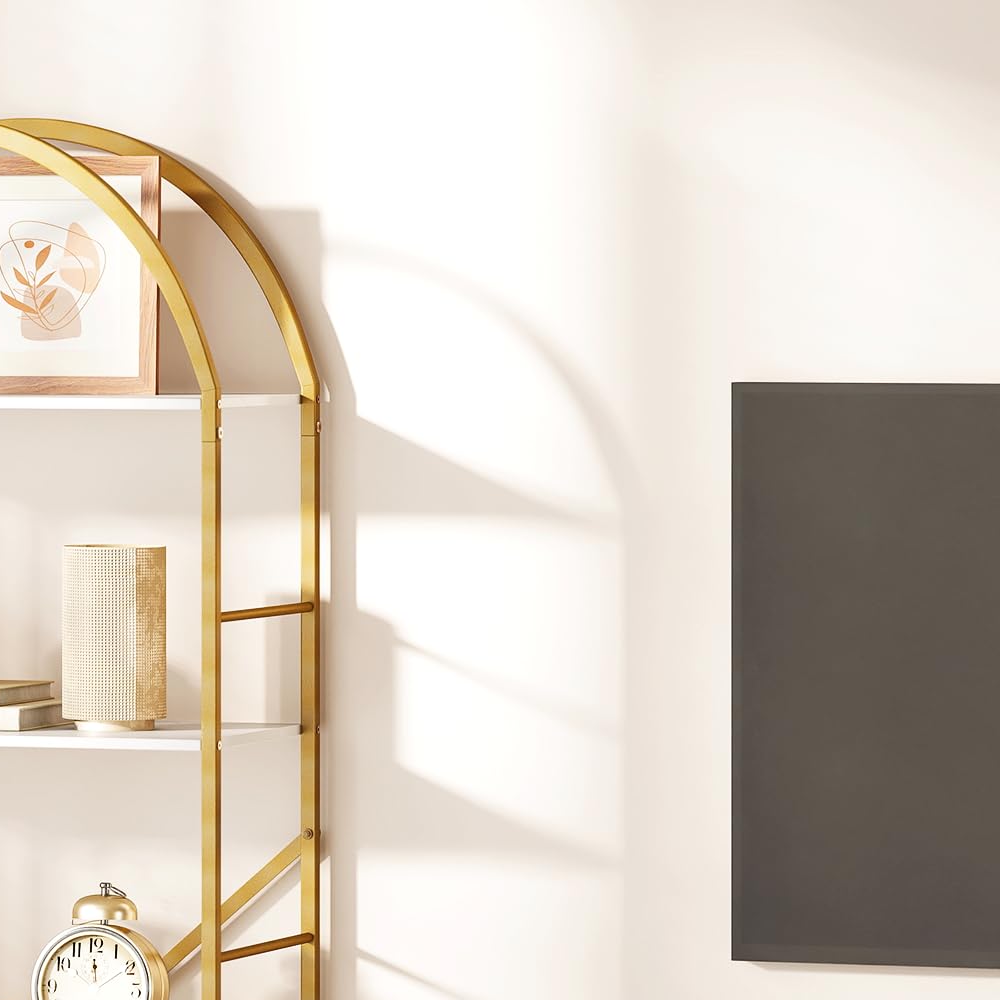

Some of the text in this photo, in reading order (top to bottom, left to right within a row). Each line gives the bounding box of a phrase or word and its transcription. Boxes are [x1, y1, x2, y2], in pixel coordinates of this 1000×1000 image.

[72, 941, 82, 958] 11
[89, 937, 104, 954] 12
[114, 943, 119, 960] 1
[56, 956, 72, 972] 10
[125, 959, 136, 976] 2
[47, 978, 58, 994] 9
[130, 982, 142, 998] 3
